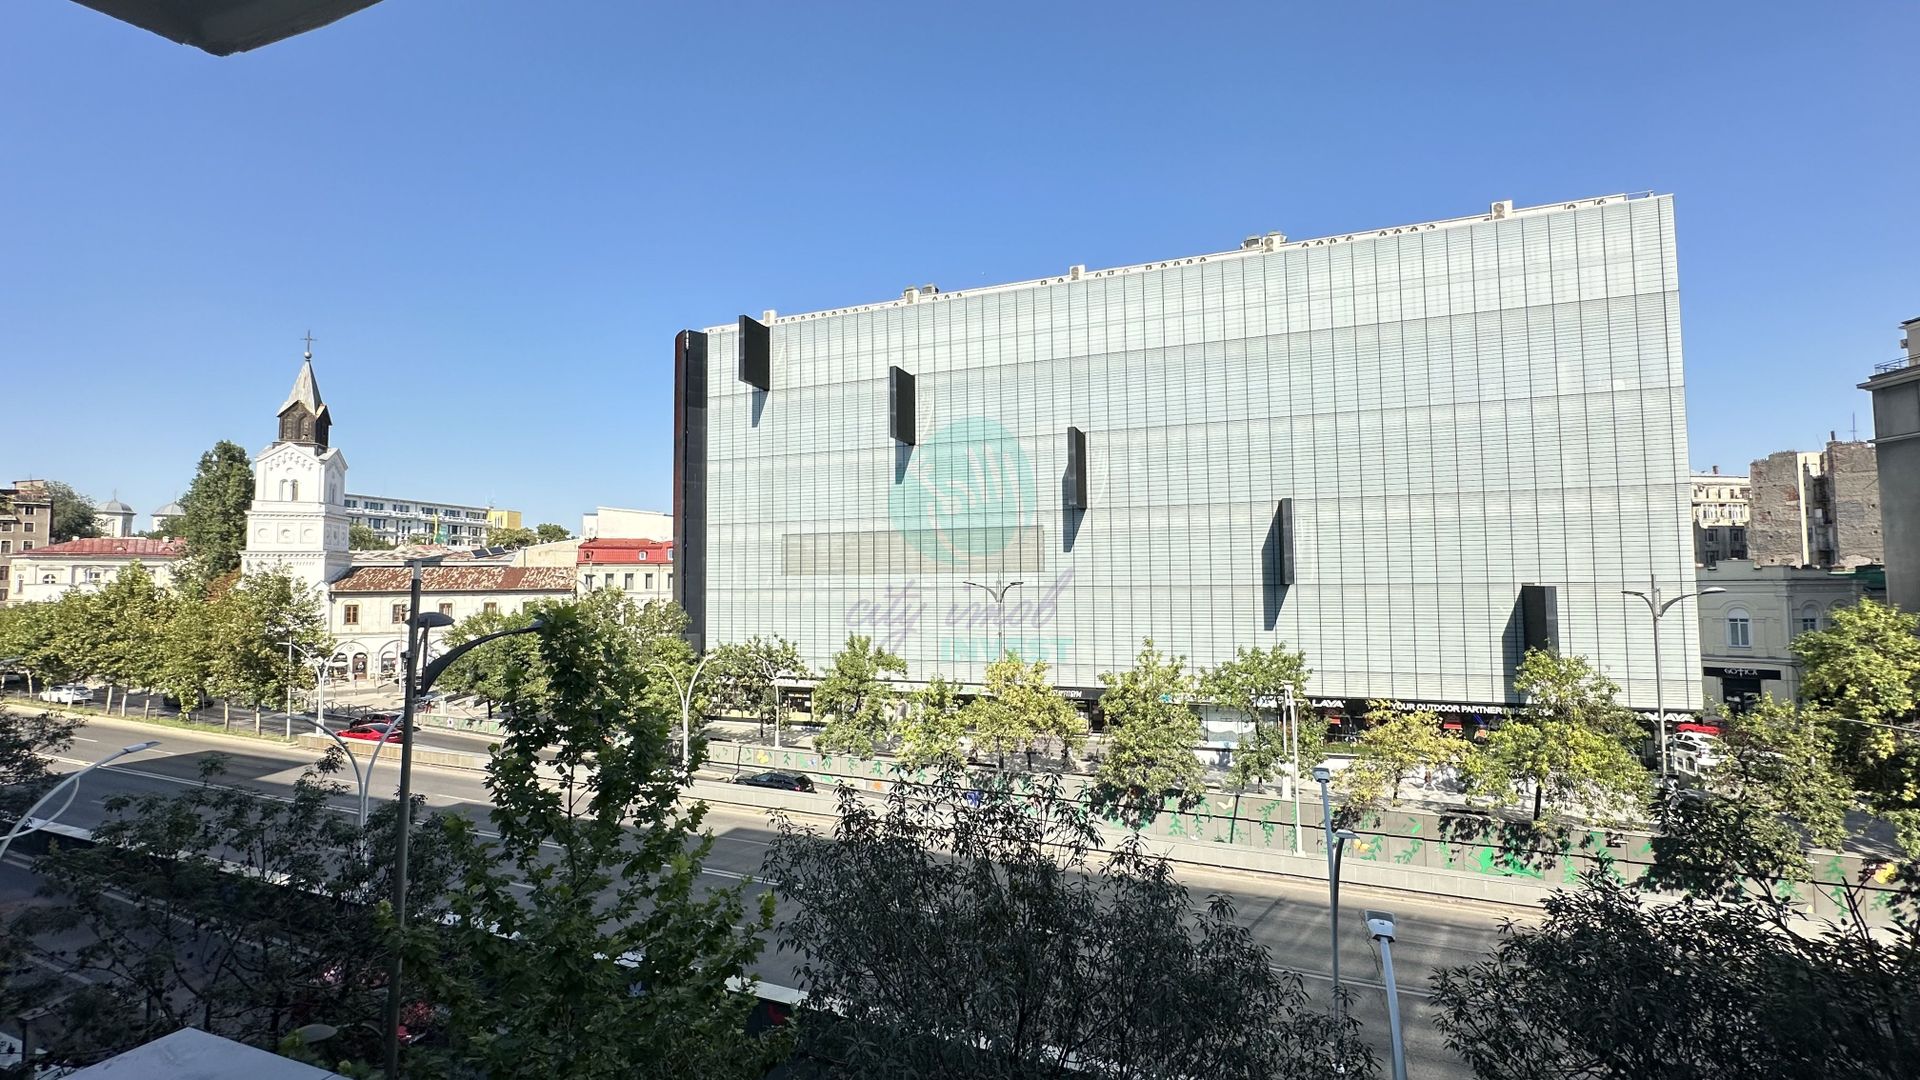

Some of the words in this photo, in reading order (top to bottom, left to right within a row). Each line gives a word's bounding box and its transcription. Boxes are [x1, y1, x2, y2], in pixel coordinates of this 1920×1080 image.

[1391, 702, 1415, 712] YOUR
[1417, 703, 1460, 713] OUTDOOR
[1461, 705, 1502, 715] PARTNER
